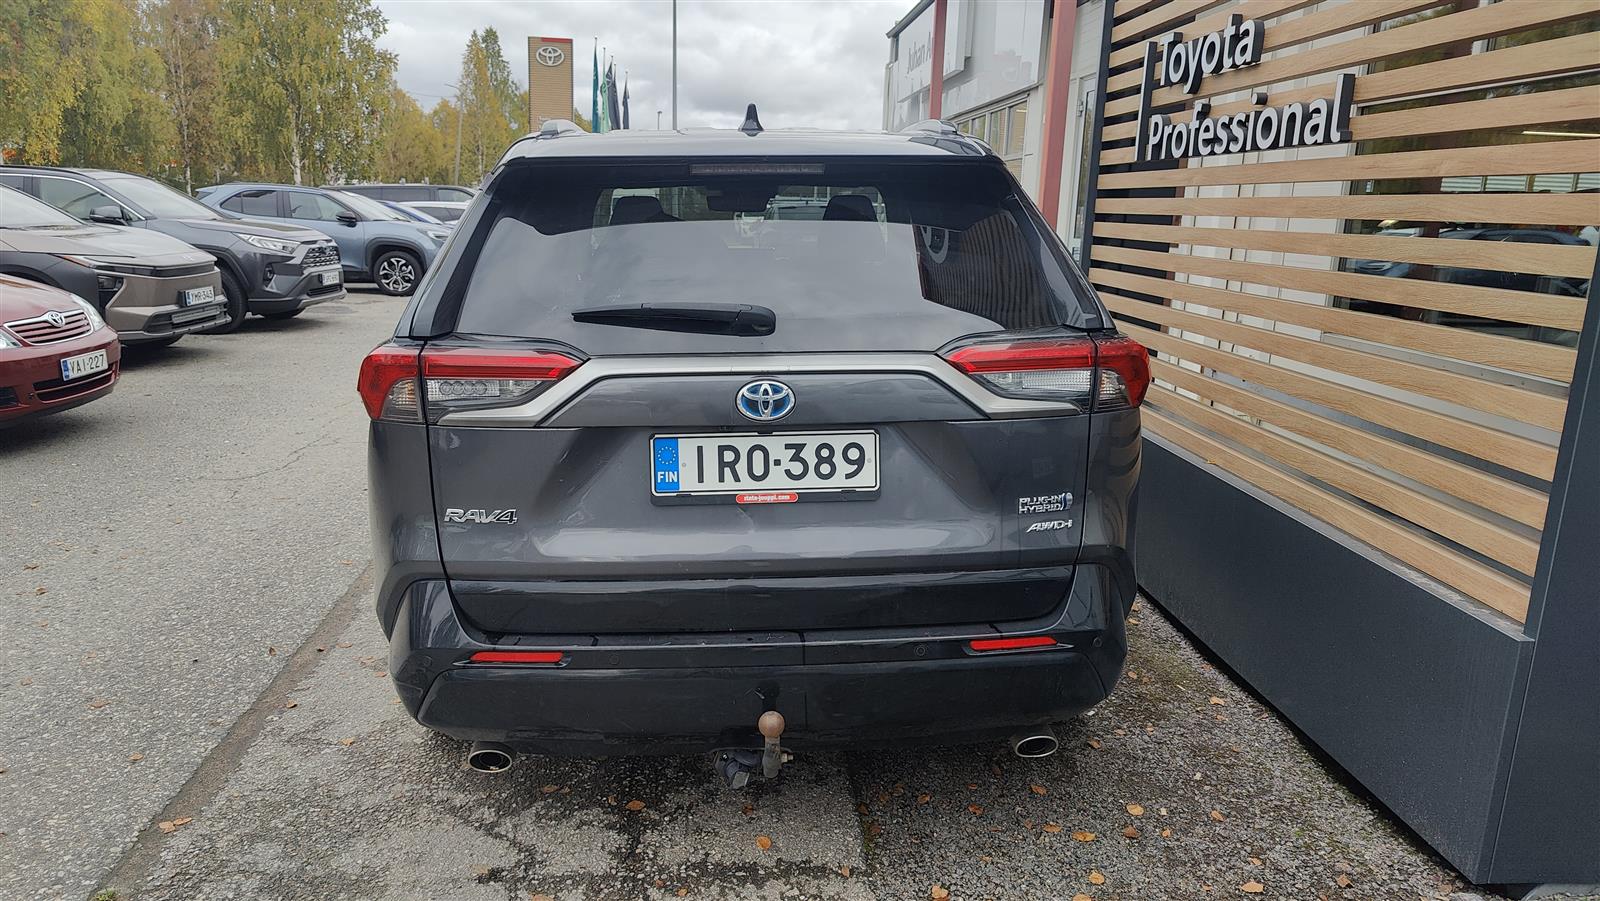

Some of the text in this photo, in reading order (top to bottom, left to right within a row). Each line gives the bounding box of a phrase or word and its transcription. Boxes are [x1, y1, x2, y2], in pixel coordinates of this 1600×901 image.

[1159, 14, 1264, 94] Toyota
[1147, 73, 1355, 161] Professional
[69, 353, 105, 375] VAI-227
[696, 441, 866, 484] IRO-389
[657, 471, 678, 483] FIN
[1019, 495, 1062, 505] PLUG-IN
[1019, 503, 1063, 514] HYBRID
[443, 508, 518, 525] RAV4
